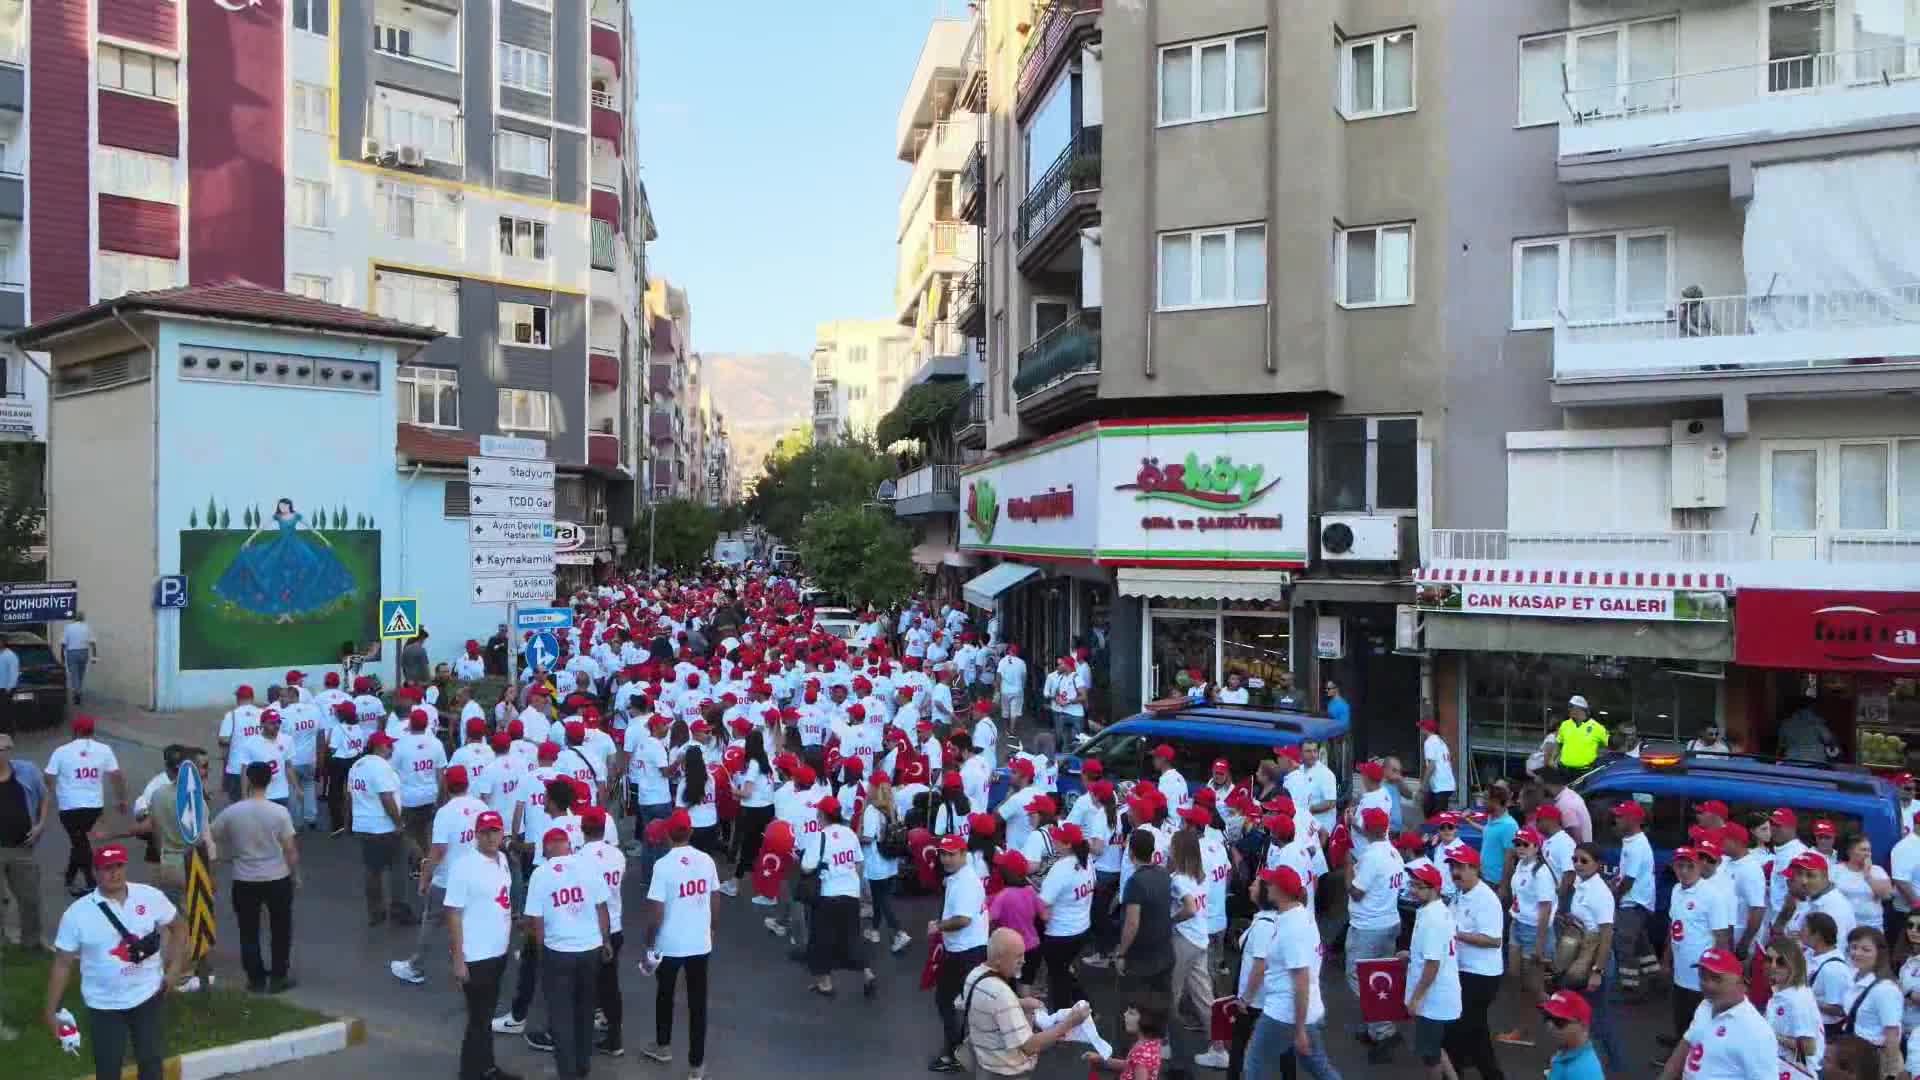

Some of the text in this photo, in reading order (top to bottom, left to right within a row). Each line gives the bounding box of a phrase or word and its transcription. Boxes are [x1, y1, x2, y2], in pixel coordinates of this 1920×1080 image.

[509, 466, 552, 480] Stadyum
[509, 496, 552, 508] TCDD Gar
[162, 578, 181, 605] P
[4, 595, 72, 610] CUMHURİYET
[1468, 593, 1502, 608] CAN
[1508, 595, 1566, 609] KASAP
[1572, 597, 1594, 610] ET
[295, 719, 315, 731] 100
[854, 746, 872, 756] 100
[413, 759, 433, 772] 100
[75, 767, 98, 780] 100
[530, 793, 544, 806] 10
[460, 829, 474, 844] 10
[832, 850, 855, 865] 100
[679, 879, 707, 898] 100
[551, 887, 585, 908] 100
